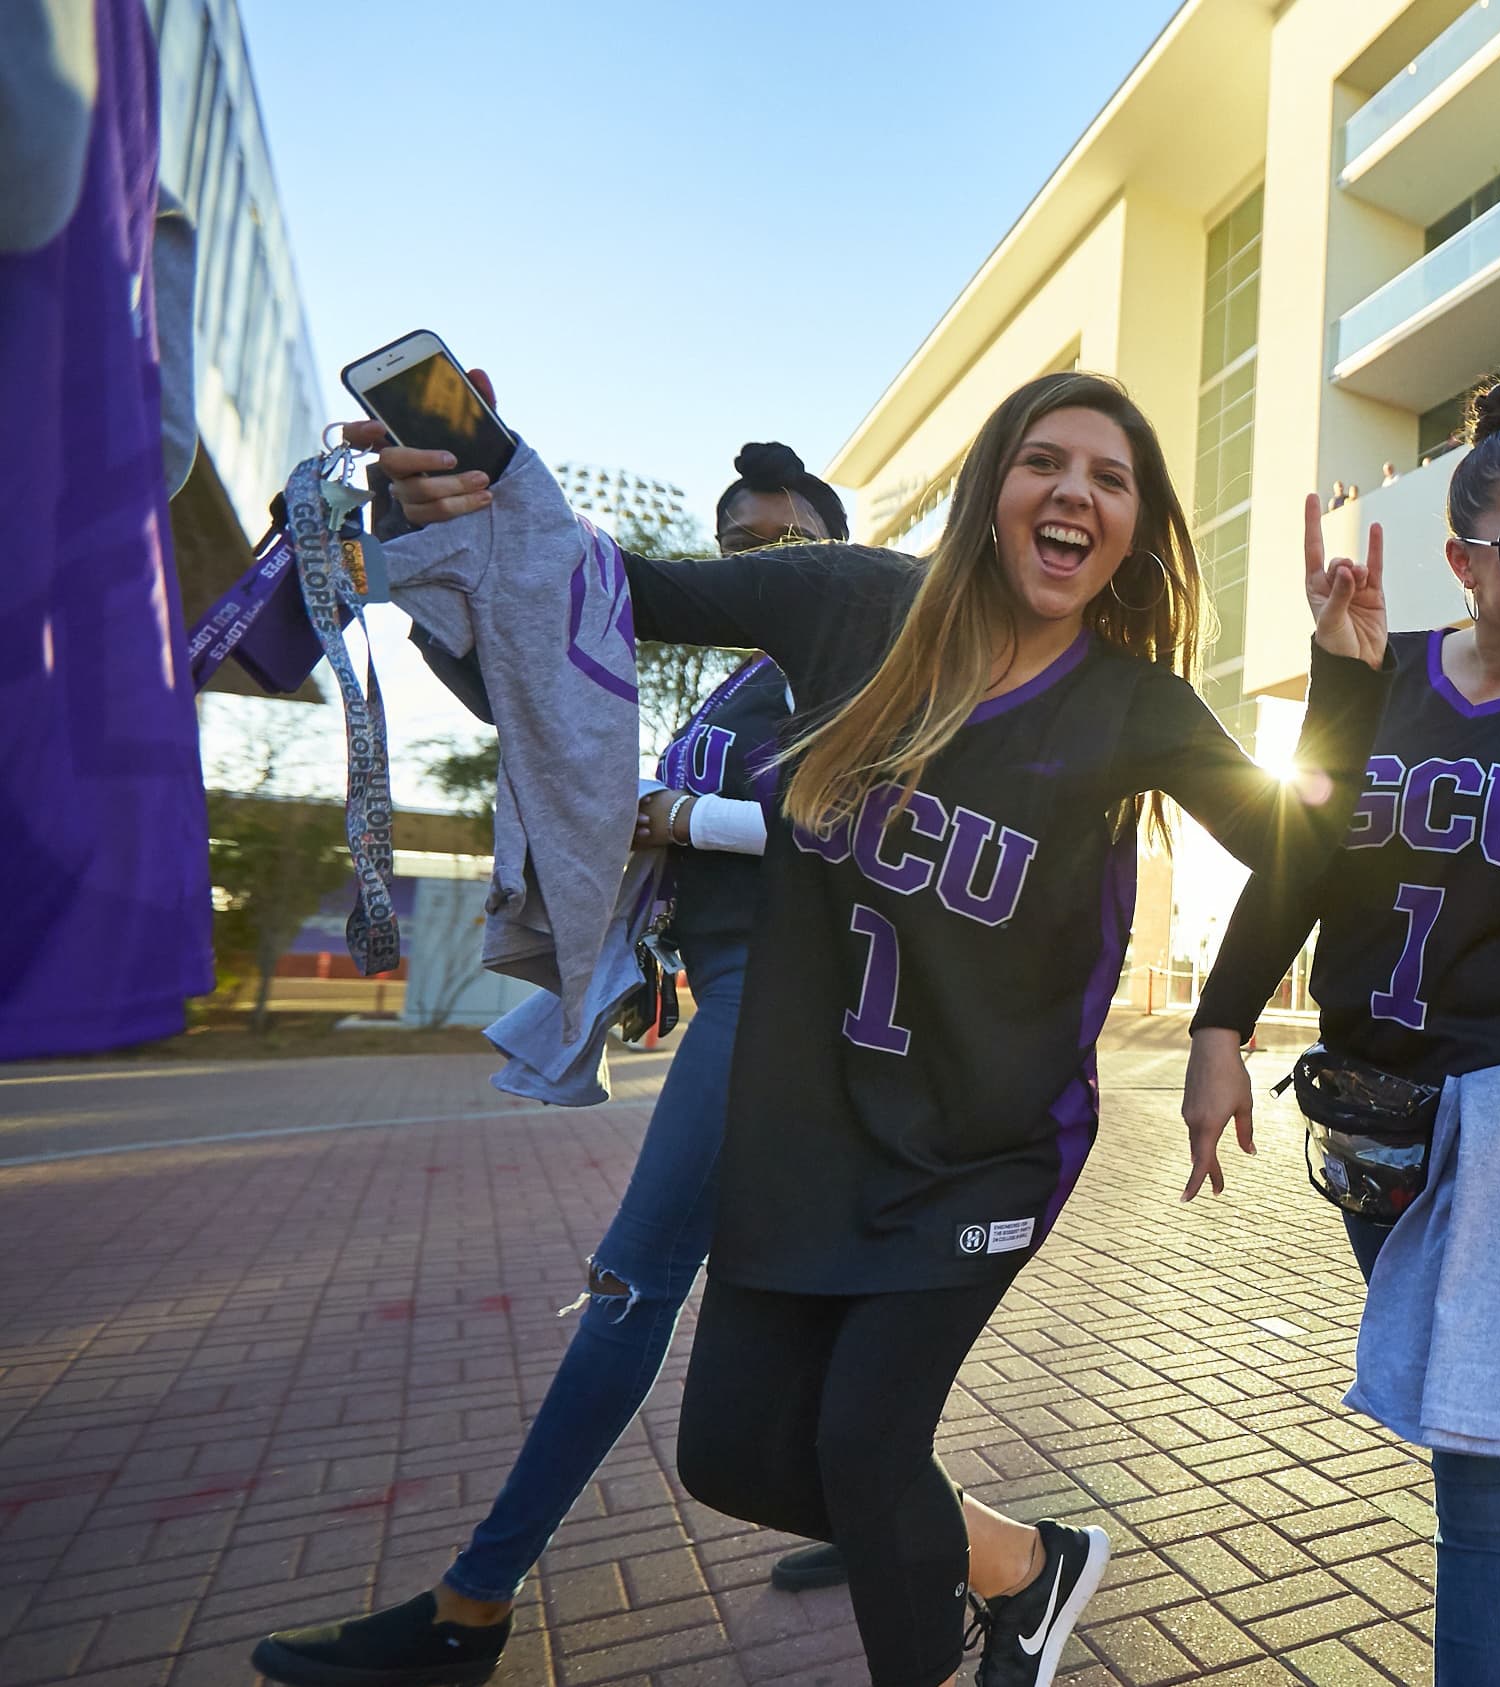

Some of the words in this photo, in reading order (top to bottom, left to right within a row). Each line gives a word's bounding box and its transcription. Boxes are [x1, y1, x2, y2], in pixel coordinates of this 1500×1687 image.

[293, 502, 323, 551] GCU
[213, 602, 241, 627] GCU
[303, 558, 337, 633] LOPES
[188, 625, 219, 661] LOPE
[210, 620, 248, 661] LOPES
[338, 667, 366, 717] GCU
[350, 723, 369, 799] LOPES
[351, 835, 378, 885] GCU
[366, 889, 394, 958] LOPES
[842, 903, 912, 1056] 1
[1370, 882, 1446, 1030] 1
